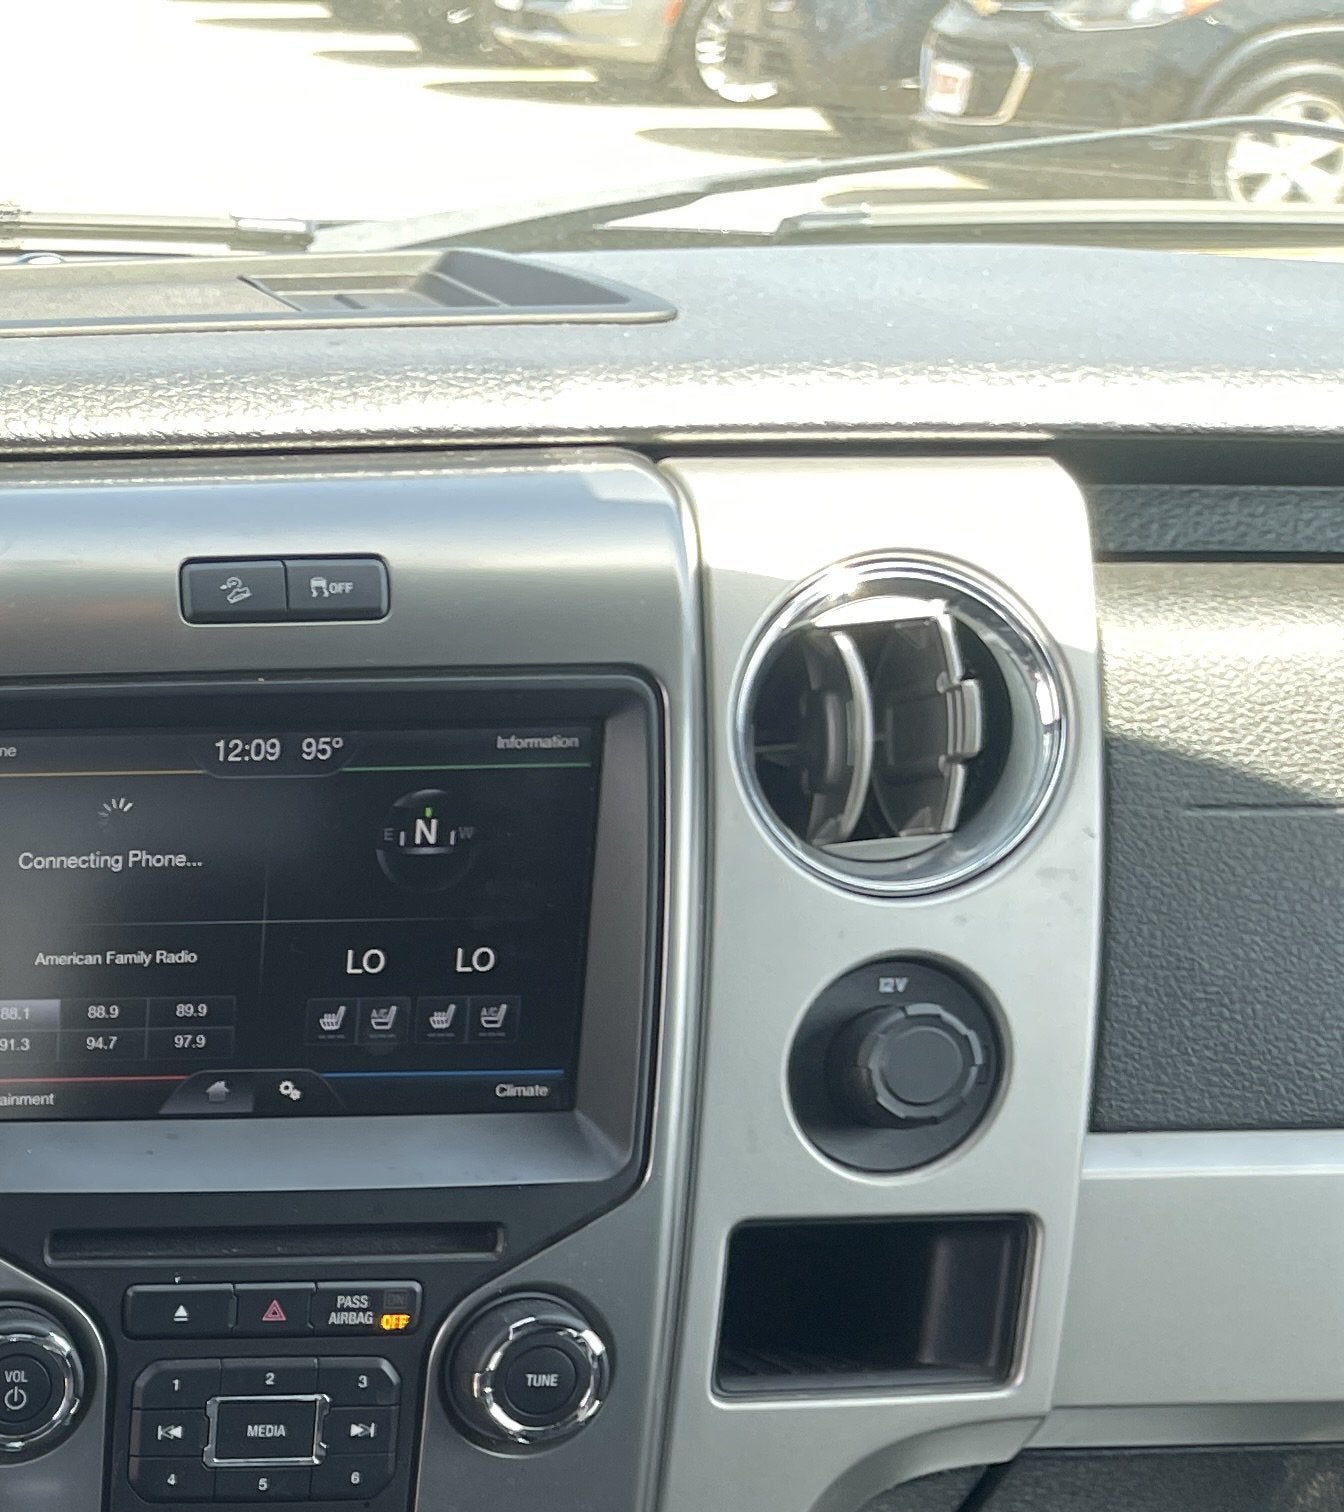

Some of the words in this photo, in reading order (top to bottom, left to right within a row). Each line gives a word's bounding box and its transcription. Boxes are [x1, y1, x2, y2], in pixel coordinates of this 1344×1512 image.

[328, 581, 354, 594] OFF
[496, 735, 580, 750] Information
[215, 738, 281, 763] 12:09
[383, 828, 394, 841] E
[414, 818, 438, 845] N
[18, 850, 123, 872] Connecting
[128, 850, 203, 869] Phone...
[34, 952, 103, 967] American
[106, 950, 153, 968] Family
[155, 949, 199, 965] Radio
[346, 948, 386, 975] LO
[455, 947, 496, 973] LO
[0, 1006, 31, 1021] 88.1
[87, 1005, 120, 1020] 88.9
[175, 1003, 208, 1018] 89.9
[86, 1036, 118, 1051] 94.7
[174, 1034, 207, 1049] 97.9
[495, 1082, 550, 1098] Climate
[336, 1294, 368, 1309] PASS
[328, 1311, 374, 1326] AIRBAG
[380, 1313, 411, 1331] OFF
[4, 1370, 29, 1384] VOL
[265, 1372, 275, 1386] 2
[358, 1375, 368, 1389] 3
[525, 1374, 559, 1388] TUNE
[172, 1378, 180, 1392] 1
[247, 1424, 286, 1438] MEDIA
[167, 1473, 177, 1486] 4
[258, 1477, 269, 1491] 5
[350, 1471, 360, 1485] 6
